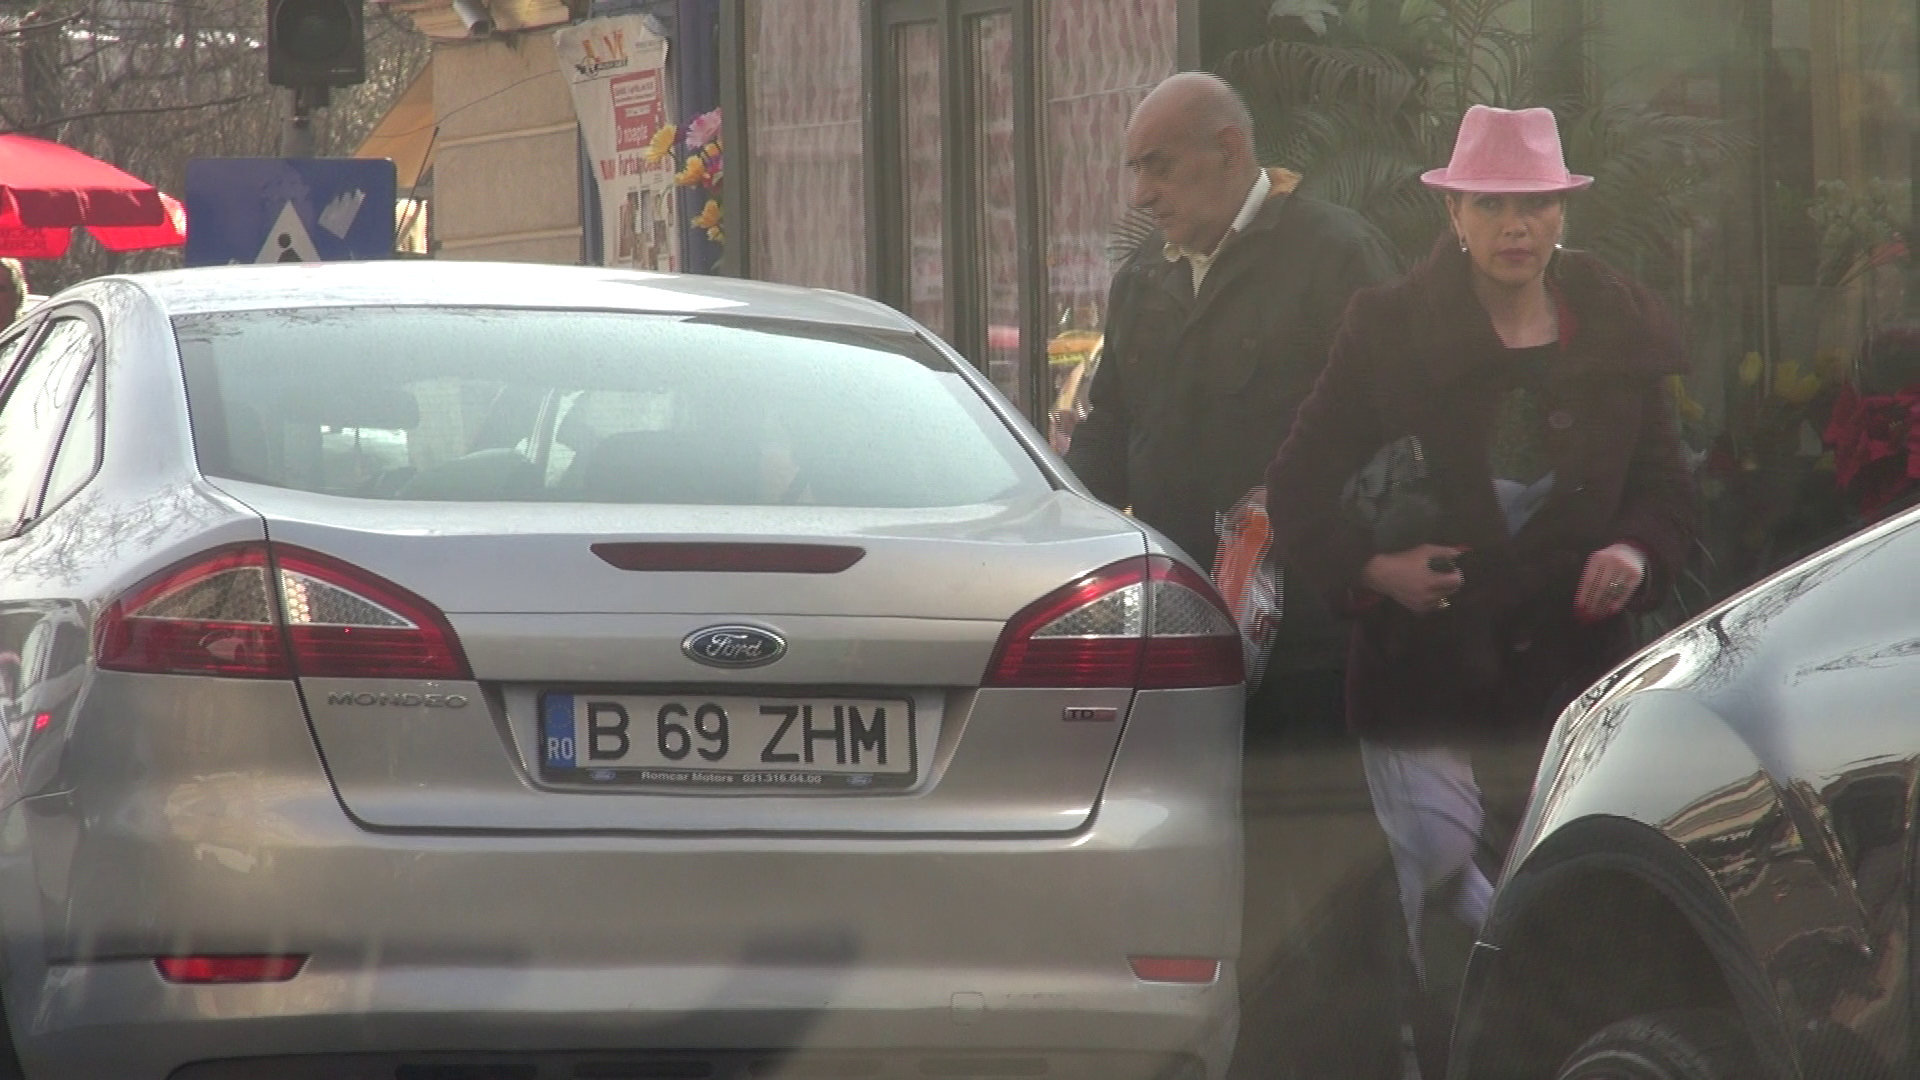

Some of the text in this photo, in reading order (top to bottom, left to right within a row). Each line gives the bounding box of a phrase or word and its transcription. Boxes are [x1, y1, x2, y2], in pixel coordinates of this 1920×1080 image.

[705, 633, 763, 658] Ford
[327, 691, 470, 709] MONDEO
[586, 702, 887, 765] B 69 ZHM
[547, 737, 573, 761] RO
[640, 770, 822, 785] Romcar Motors 021.316.04.00
